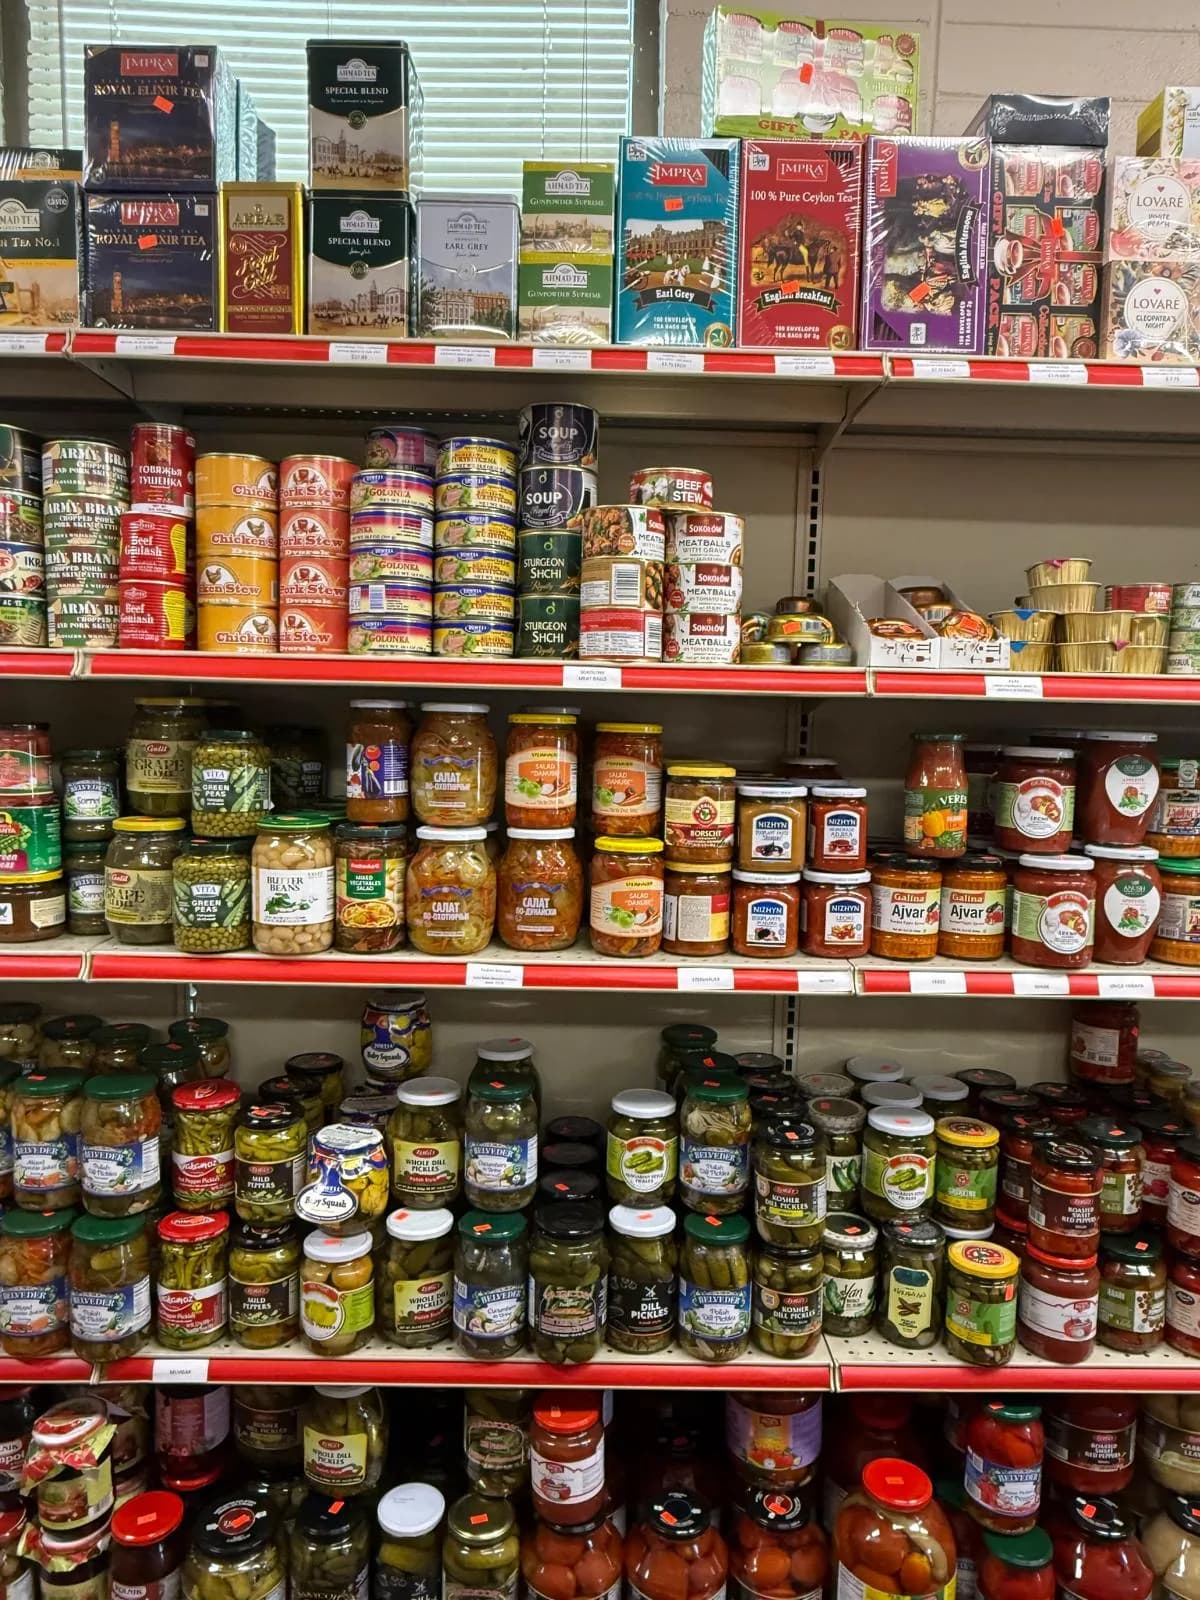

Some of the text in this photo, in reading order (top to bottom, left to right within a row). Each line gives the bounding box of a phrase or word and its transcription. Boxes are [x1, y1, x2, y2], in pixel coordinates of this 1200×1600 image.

[94, 84, 135, 97] ROYAL
[325, 85, 389, 96] SPECIAL BLEND
[758, 119, 799, 133] GIFT
[654, 163, 704, 183] IMPRA
[780, 163, 825, 179] IMPRA
[546, 180, 590, 191] AHMAD TEA
[750, 191, 767, 201] 100
[767, 191, 778, 201] %
[779, 192, 801, 202] Pure
[802, 192, 836, 205] Ceylon
[1136, 195, 1184, 208] LOVARÉ
[21, 215, 40, 225] TEA
[96, 234, 206, 246] ROYAL TEA
[328, 236, 391, 247] SPECIAL BLEND
[445, 242, 489, 252] EARL GREY
[543, 273, 587, 283] AHMAD TEA
[655, 288, 695, 302] Earl Grey
[1133, 296, 1181, 310] LOVARÉ
[774, 332, 786, 340] TEA
[539, 426, 579, 440] SOUP
[59, 446, 101, 462] ARMY
[138, 464, 183, 478] ГОВЯЖЬЯ
[675, 479, 703, 491] BEEF
[306, 485, 346, 498] Stew
[672, 490, 703, 504] STEW
[526, 491, 563, 505] SOUP
[47, 502, 81, 515] ARMY
[130, 535, 154, 547] Beef
[211, 534, 267, 547] Chicken
[305, 535, 344, 547] Stew
[678, 539, 731, 549] MEATBALLS
[524, 557, 565, 568] STURGEON
[530, 567, 563, 579] SHCHI
[225, 584, 260, 595] Stew
[307, 584, 348, 596] Stew
[687, 588, 737, 598] MEATBALLS
[60, 602, 100, 616] ARMY
[125, 602, 145, 614] Beef
[524, 621, 567, 632] STURGEON
[216, 632, 272, 644] Chicken
[294, 631, 331, 643] Stew
[532, 630, 565, 644] SHCHI
[681, 638, 733, 648] MEATBALLS
[134, 759, 186, 771] GRAPE
[206, 769, 226, 779] VITA
[433, 771, 461, 783] САЛАТ
[202, 784, 230, 792] GREEN
[205, 790, 227, 798] PEAS
[758, 821, 788, 830] NIZHYN
[827, 818, 858, 827] NIZHYN
[266, 876, 304, 886] BUTTER
[195, 885, 217, 895] VITA
[269, 883, 301, 893] BEANS
[191, 899, 222, 908] GREEN
[522, 897, 551, 909] САЛАТ
[893, 892, 927, 904] Galina
[952, 892, 984, 904] Galina
[195, 905, 218, 914] PEAS
[431, 901, 460, 913] САЛАТ
[752, 906, 784, 914] NIZHYN
[831, 904, 861, 913] NIZHYN
[891, 904, 926, 920] Ajvar
[950, 904, 984, 920] Ajvar
[380, 1052, 402, 1063] Squash
[411, 1165, 440, 1174] PICKLES
[247, 1181, 276, 1190] PEPPERS
[321, 1196, 348, 1209] Squash
[771, 1194, 801, 1204] KOSHER
[242, 1302, 272, 1311] PEPPERS
[246, 1297, 266, 1305] MILD
[640, 1302, 661, 1312] DILL
[630, 1307, 670, 1320] PICKLES
[781, 1305, 810, 1313] KOSHER
